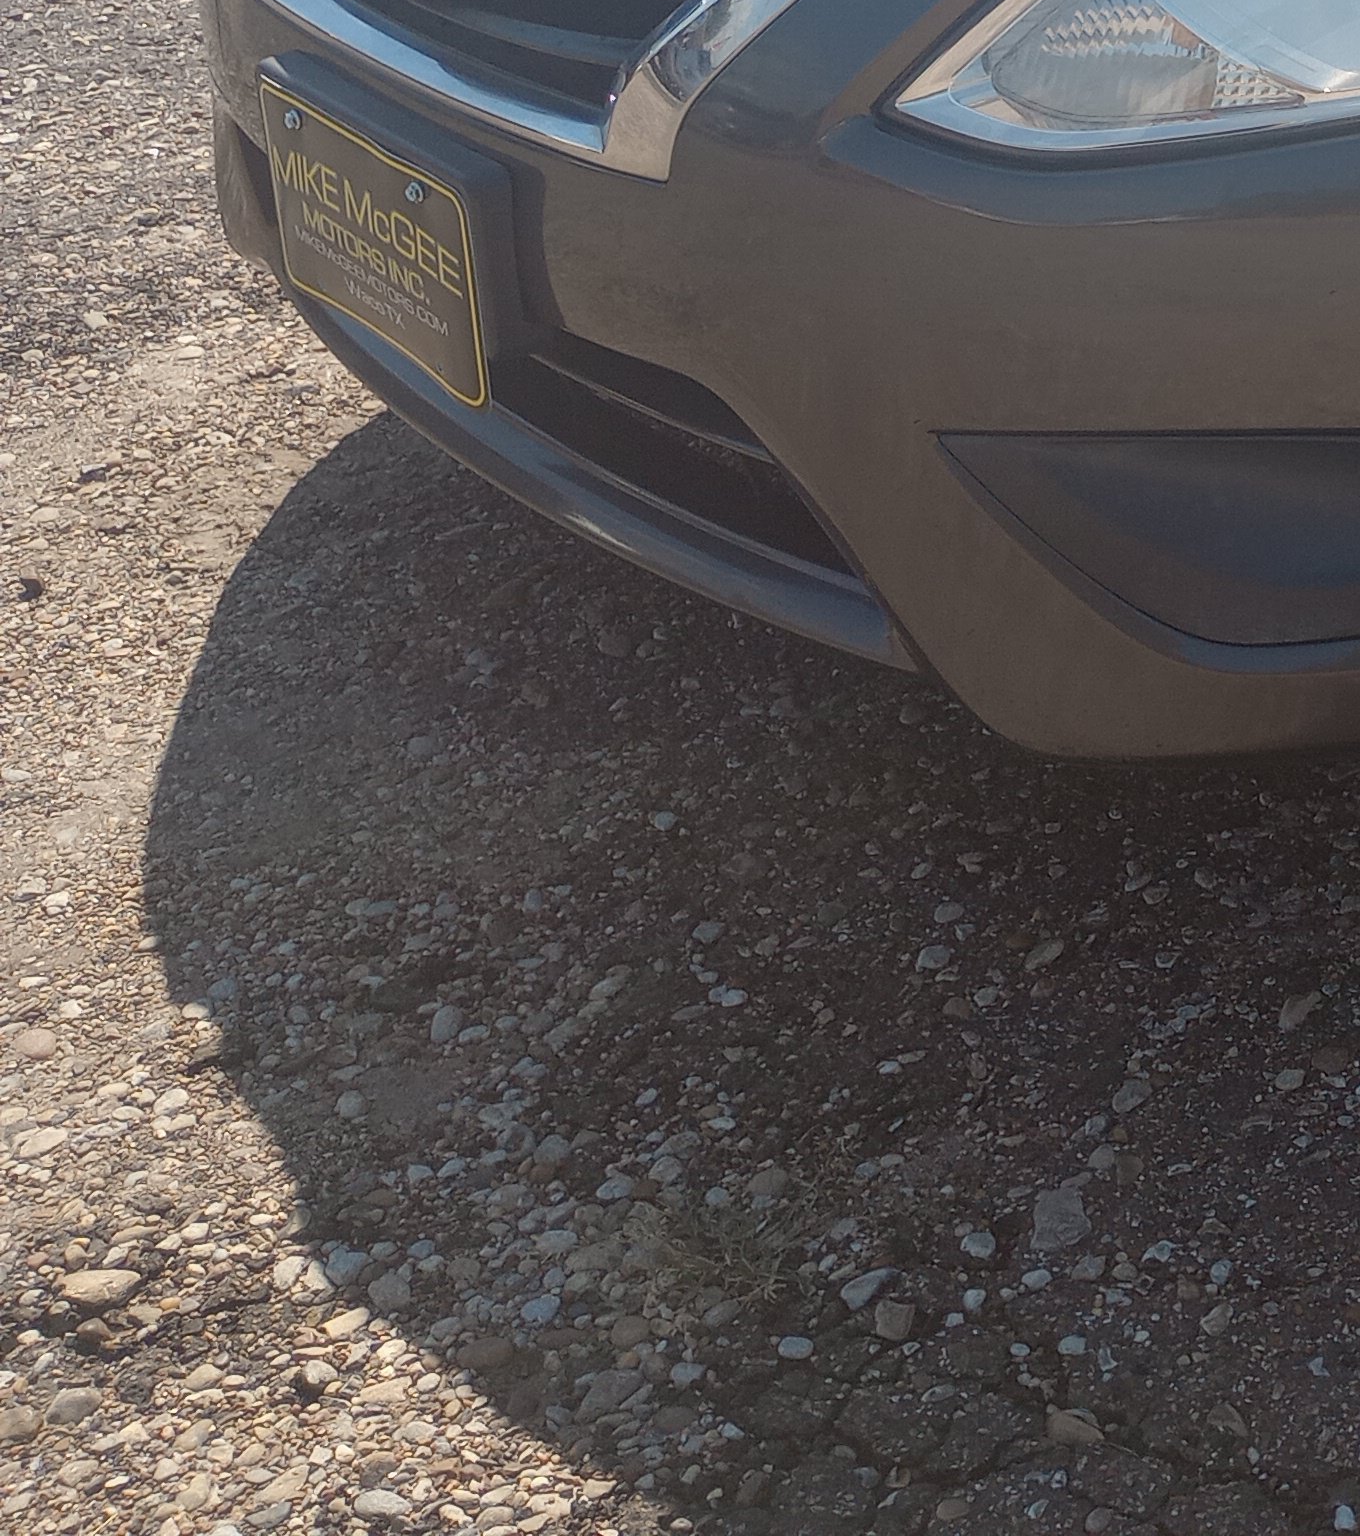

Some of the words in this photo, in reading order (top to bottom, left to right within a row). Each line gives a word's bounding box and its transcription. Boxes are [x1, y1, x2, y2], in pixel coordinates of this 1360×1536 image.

[272, 144, 341, 213] MIKE
[342, 177, 464, 300] McGEE
[302, 201, 386, 276] MOTORS
[387, 257, 431, 306] INC.
